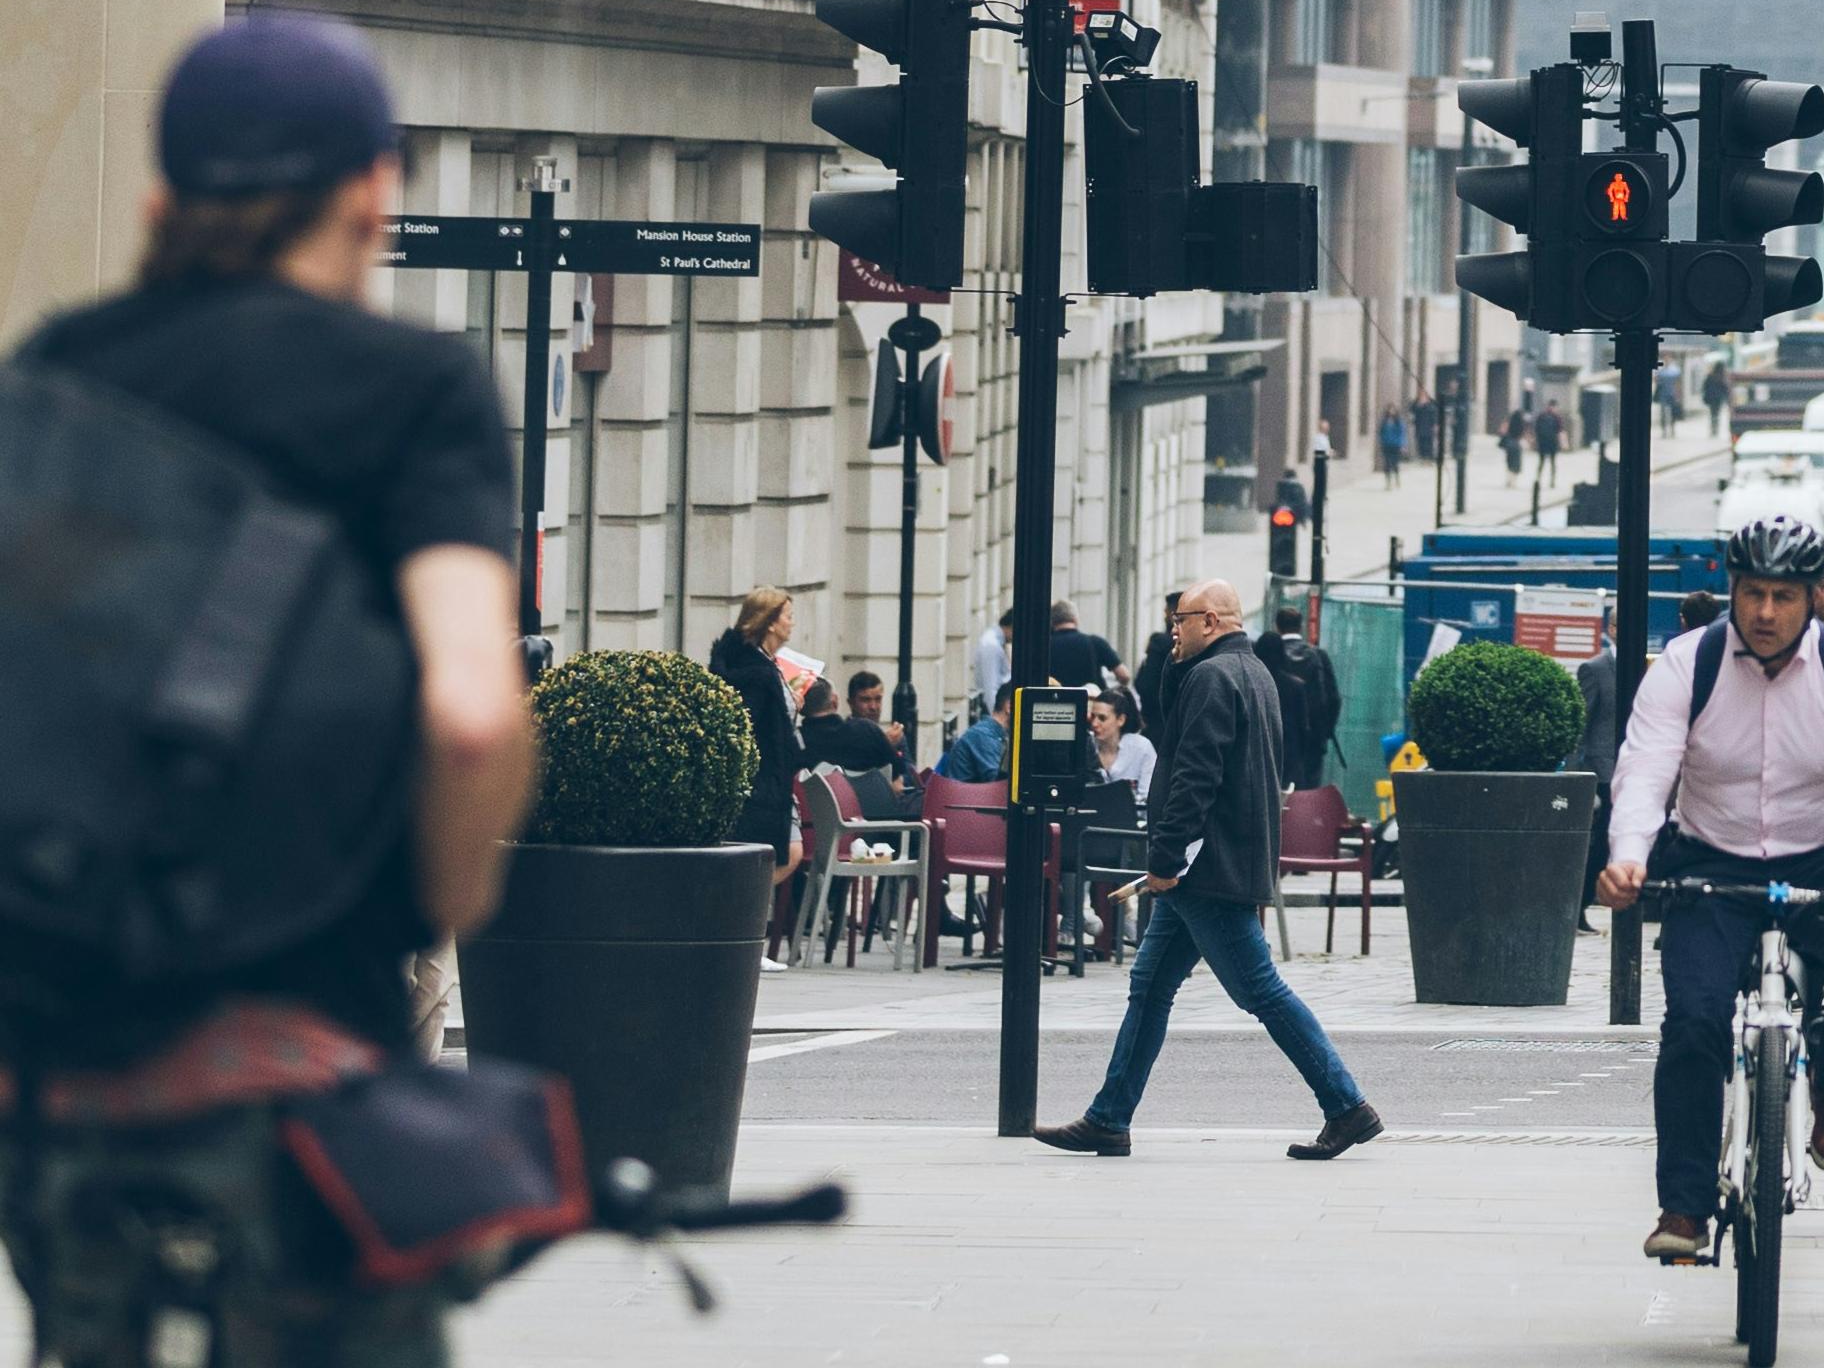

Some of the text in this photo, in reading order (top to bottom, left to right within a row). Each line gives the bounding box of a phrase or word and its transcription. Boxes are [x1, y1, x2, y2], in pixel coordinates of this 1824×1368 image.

[404, 222, 440, 234] Station
[637, 229, 752, 243] Mansion House Station
[660, 256, 751, 269] St Paul's Cathedral
[851, 257, 904, 293] NATURAL
